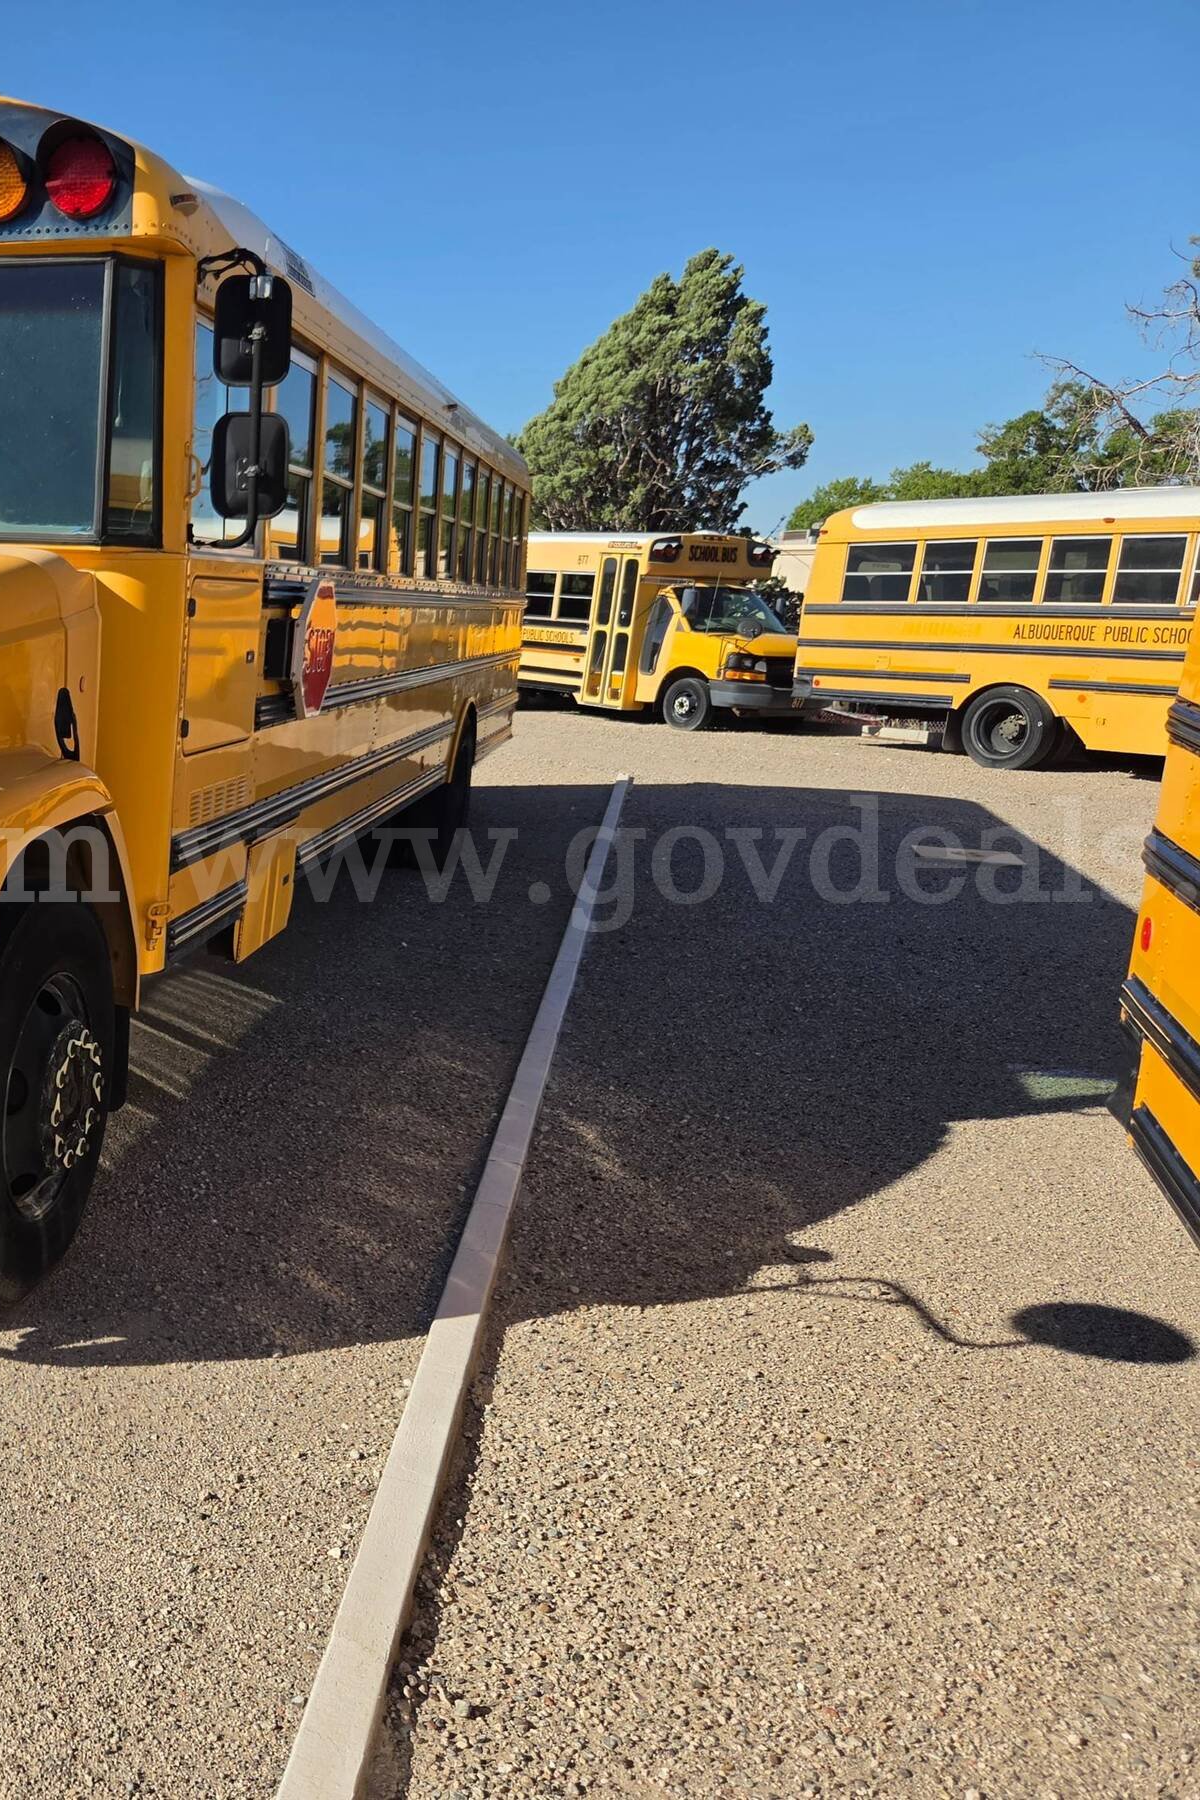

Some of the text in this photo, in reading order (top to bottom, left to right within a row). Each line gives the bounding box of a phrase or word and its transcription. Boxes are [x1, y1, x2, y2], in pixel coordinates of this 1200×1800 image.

[689, 544, 738, 563] SCHOOL BUS
[545, 630, 575, 644] SCHOOLS
[1013, 623, 1096, 642] ALBUQUERQUE
[1103, 625, 1149, 643] PUBLIC
[304, 627, 336, 674] STOP
